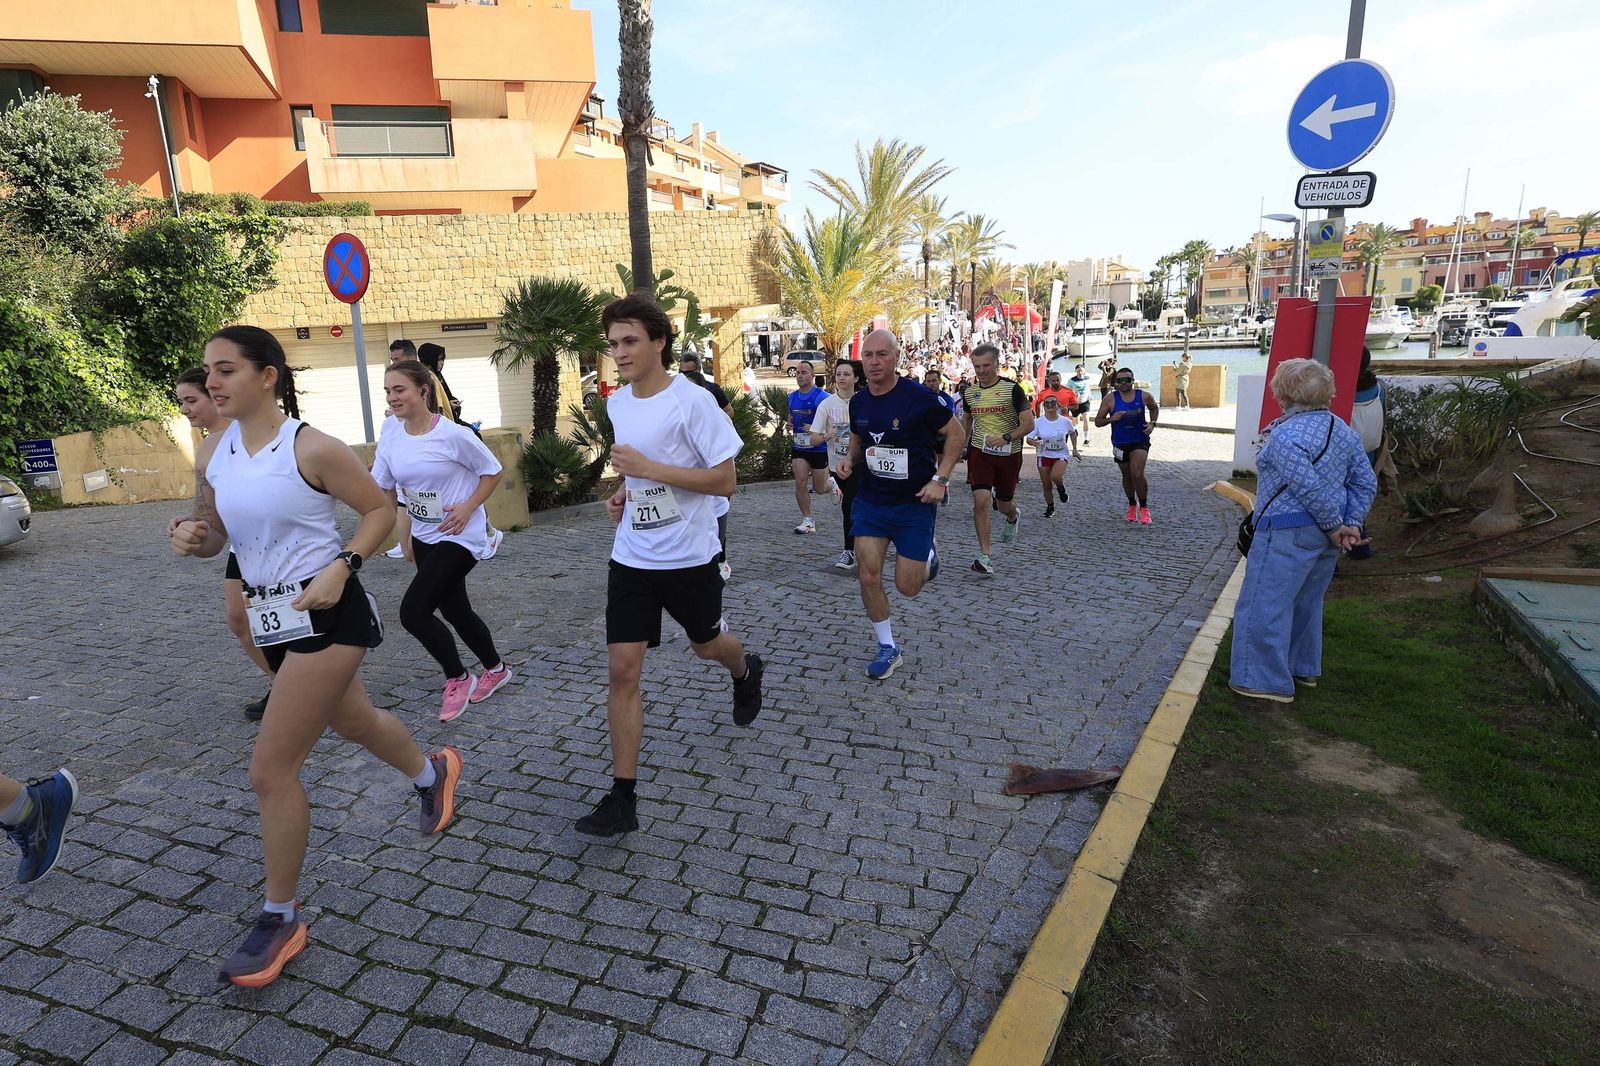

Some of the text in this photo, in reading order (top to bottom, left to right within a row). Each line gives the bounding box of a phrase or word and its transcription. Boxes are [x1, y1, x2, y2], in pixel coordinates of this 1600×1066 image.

[1303, 179, 1367, 190] ENTRADA DE
[1304, 191, 1362, 201] VEHICULOS
[877, 460, 895, 471] 192
[644, 485, 666, 497] RUN
[410, 502, 428, 517] 226
[637, 505, 660, 521] 271
[269, 583, 296, 597] RUN
[261, 611, 281, 632] 83
